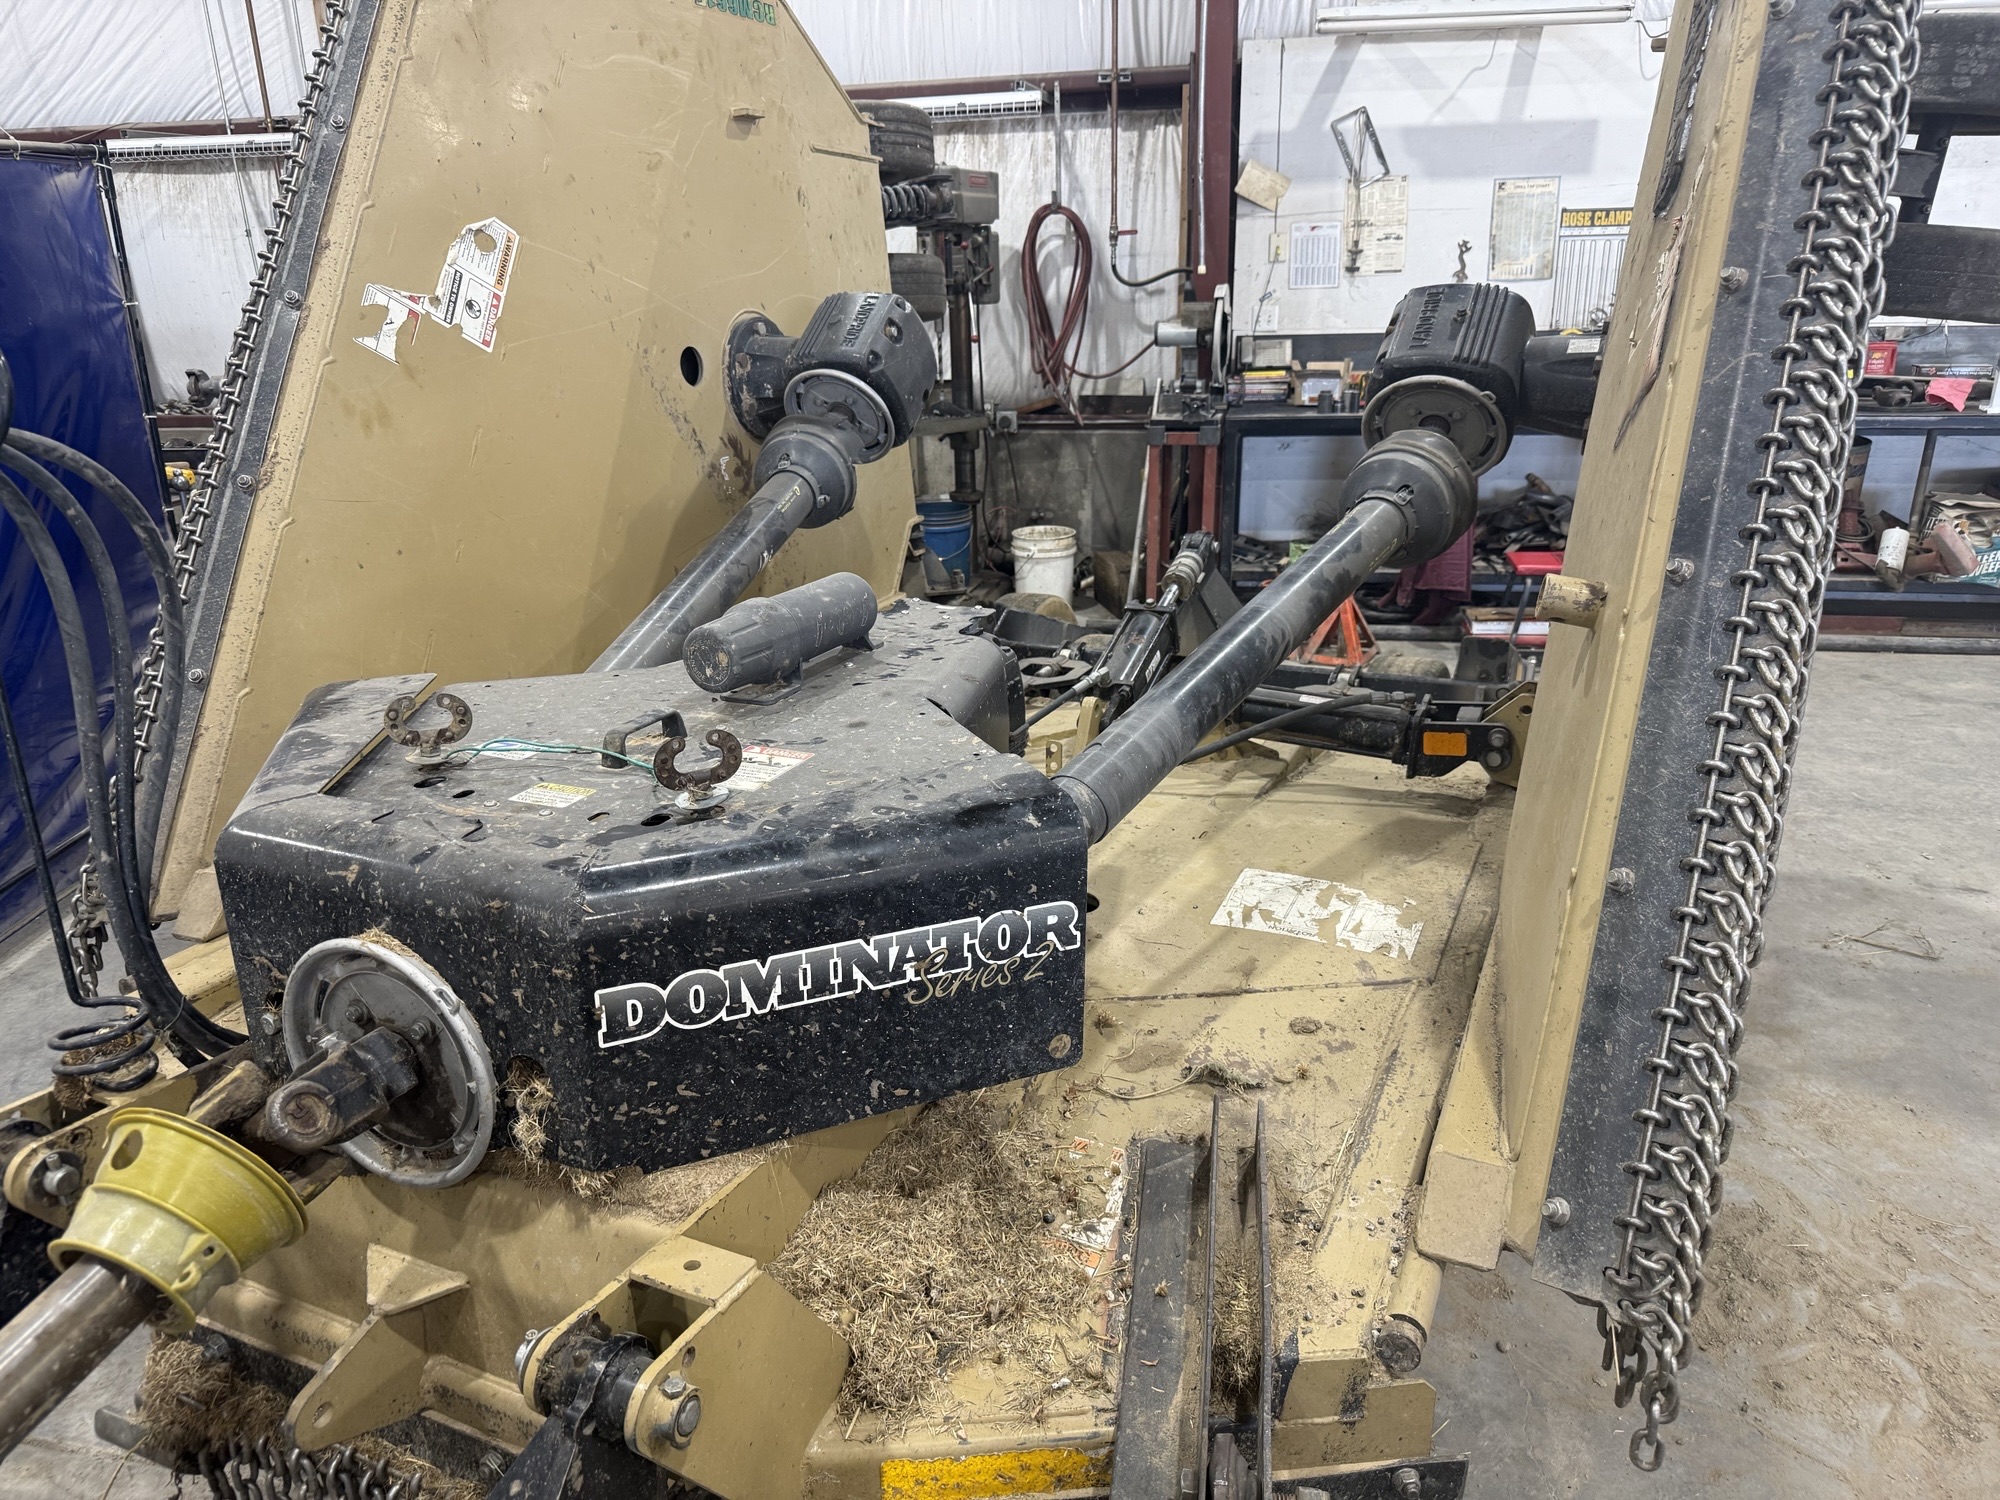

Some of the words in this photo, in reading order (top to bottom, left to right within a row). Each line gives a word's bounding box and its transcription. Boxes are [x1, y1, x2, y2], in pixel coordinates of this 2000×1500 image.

[694, 0, 776, 26] RCM66
[1562, 211, 1592, 227] HOSE
[1594, 210, 1633, 226] CLAMP
[496, 243, 512, 286] WARNING
[452, 272, 462, 292] NOTICE
[450, 293, 457, 302] TO
[444, 302, 455, 323] OWNER
[484, 307, 497, 342] DANGER
[594, 900, 1081, 1048] DOMINATOR
[906, 948, 1019, 1006] Series
[1024, 940, 1055, 982] 2
